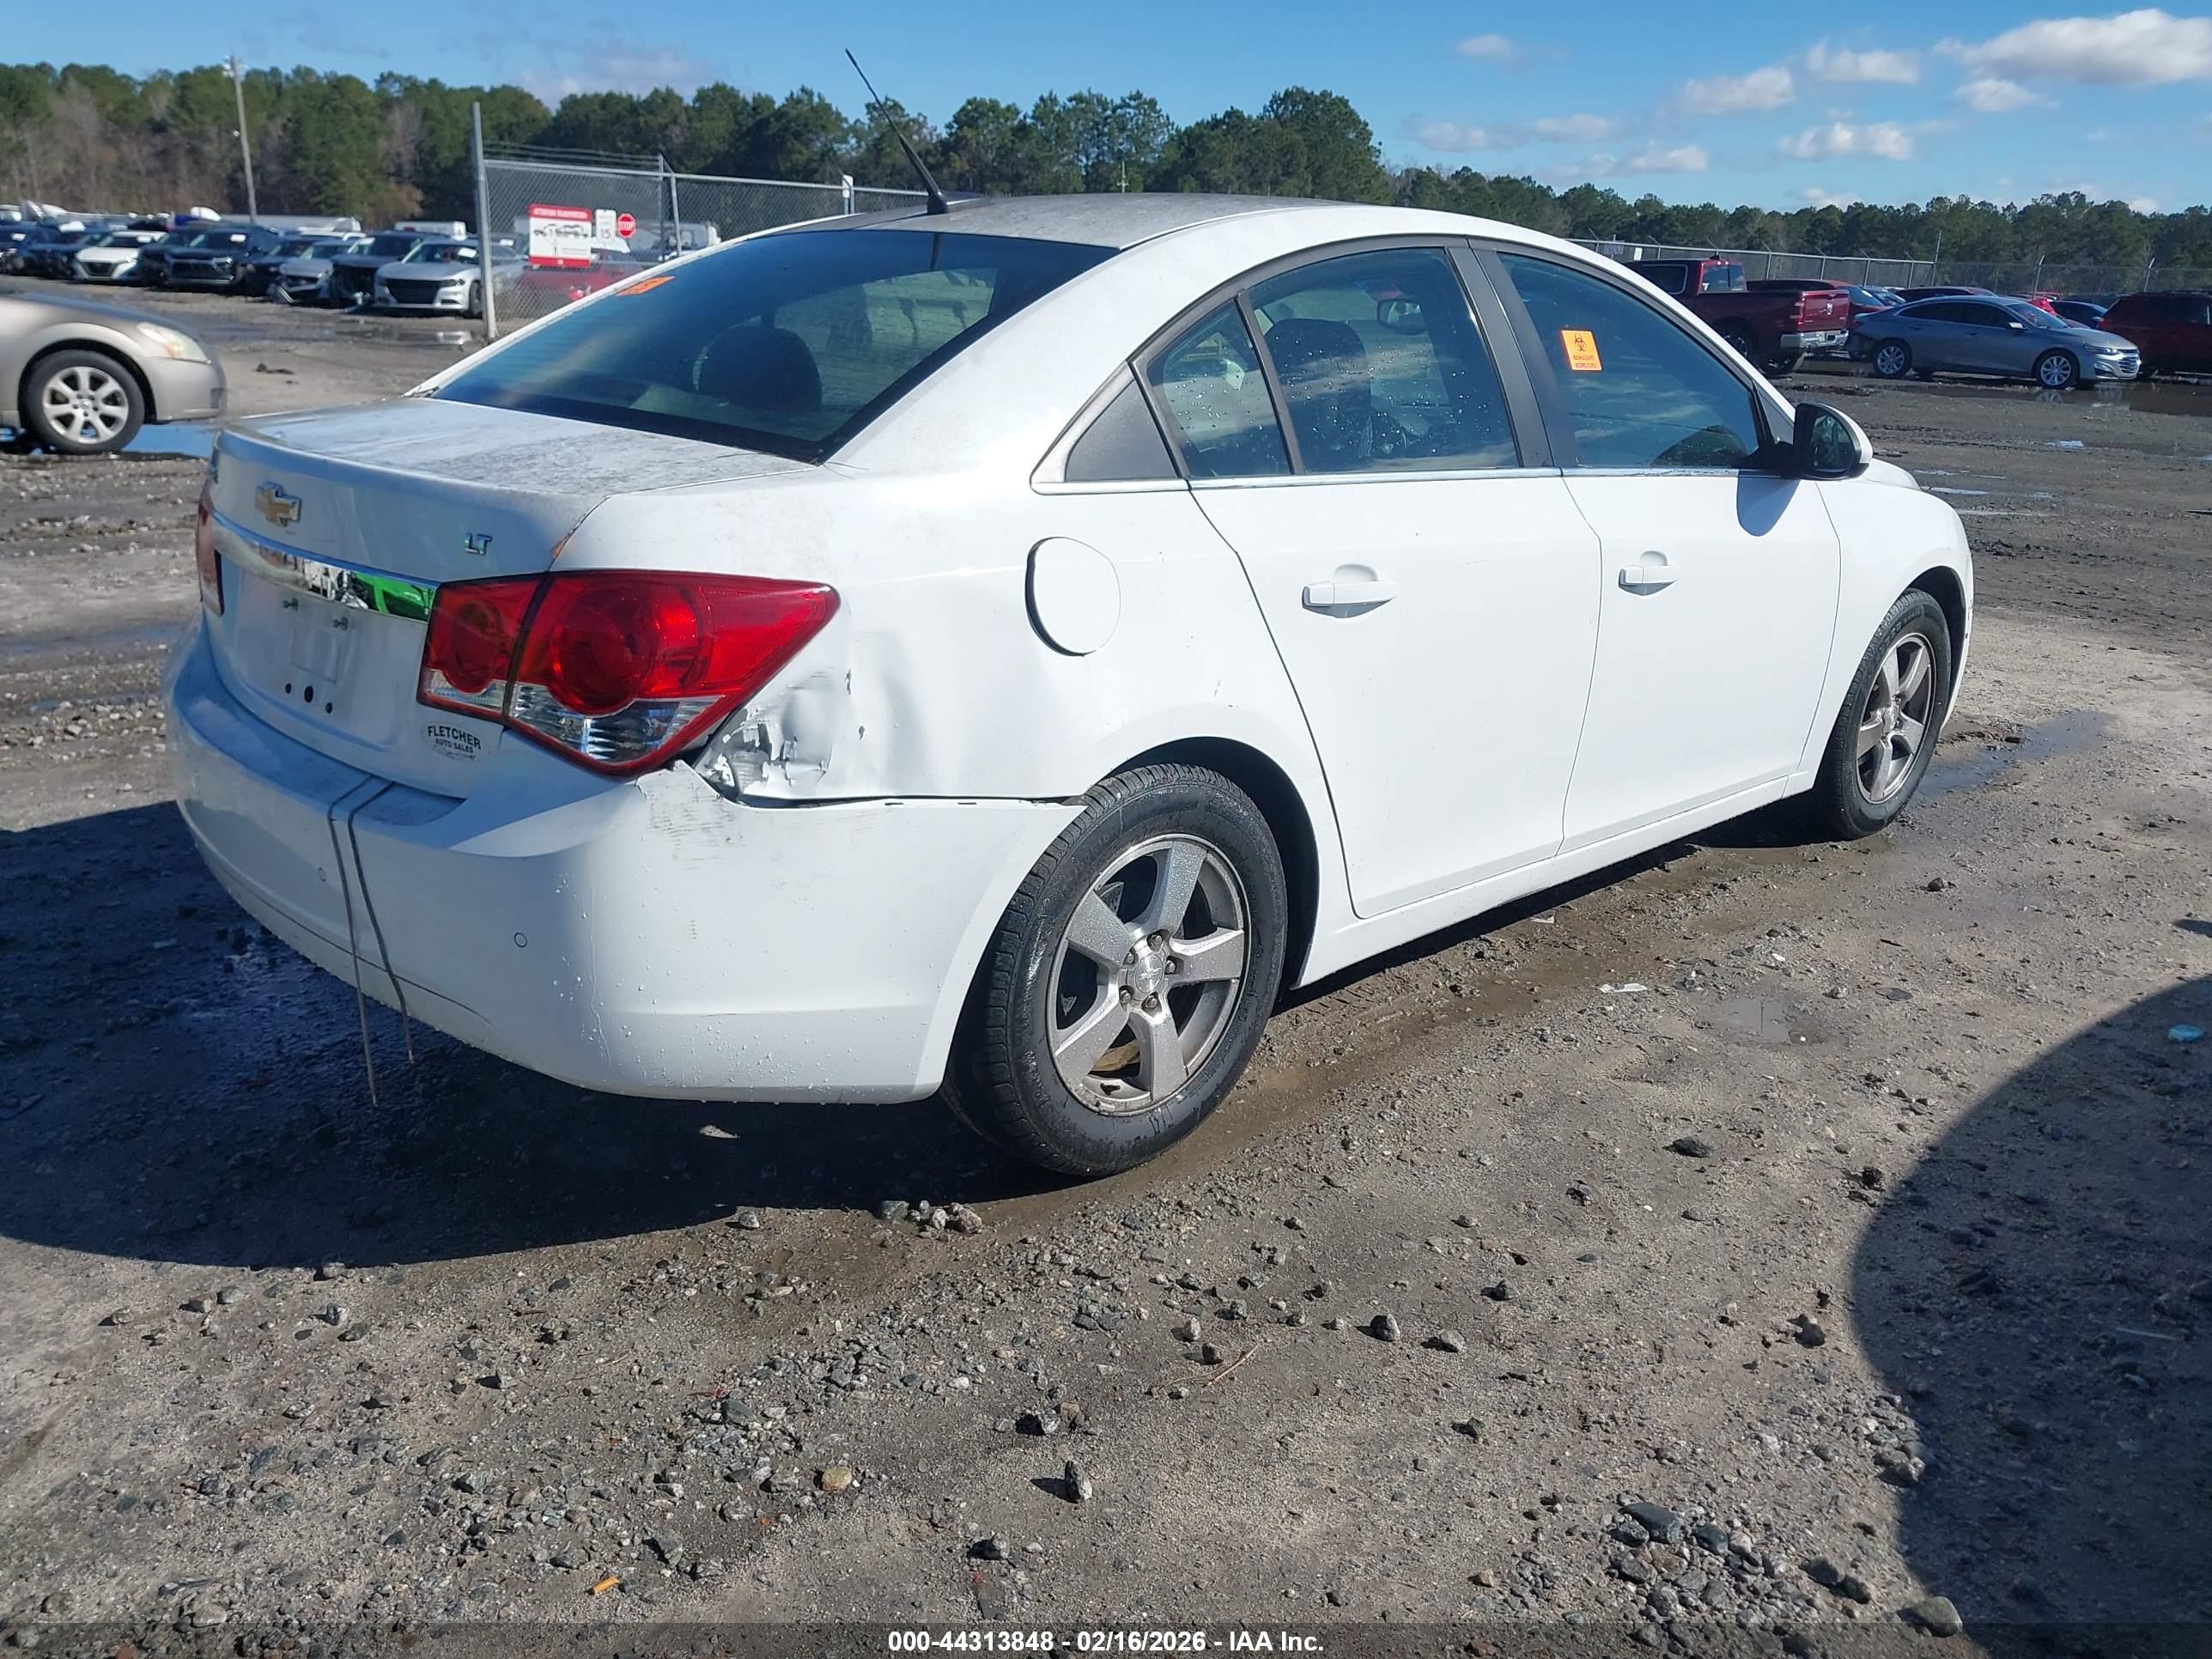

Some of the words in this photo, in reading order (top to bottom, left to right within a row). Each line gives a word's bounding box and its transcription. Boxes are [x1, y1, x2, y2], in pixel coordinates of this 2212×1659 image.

[618, 221, 635, 232] STOP
[465, 532, 493, 556] LT
[428, 725, 482, 750] FLETCHER
[435, 738, 453, 749] AUTO
[453, 742, 474, 754] SALES
